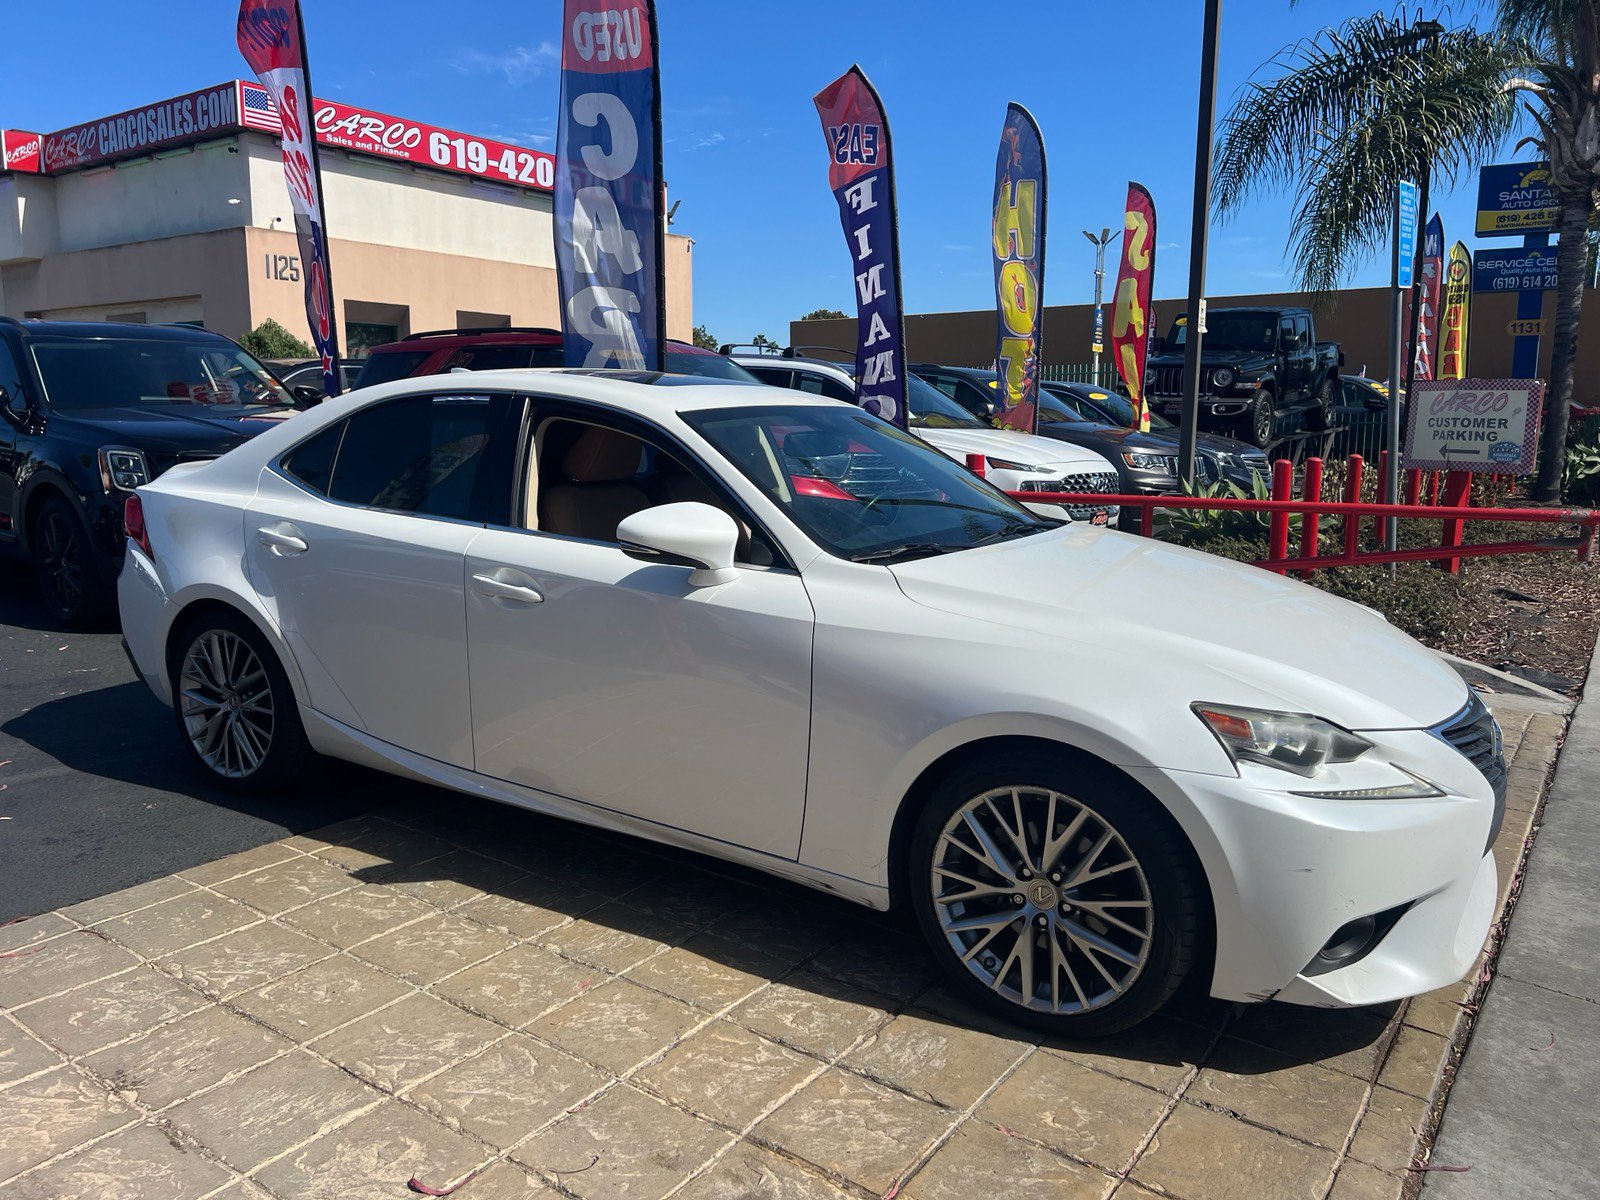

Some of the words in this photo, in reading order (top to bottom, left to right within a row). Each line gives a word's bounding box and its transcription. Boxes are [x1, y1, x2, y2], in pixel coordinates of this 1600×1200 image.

[99, 86, 235, 156] CARCOSALES.COM
[314, 106, 422, 149] CARCO
[6, 140, 39, 163] CARCO
[44, 126, 97, 165] CARCO
[326, 133, 353, 147] Sales
[355, 141, 373, 151] and
[374, 144, 410, 159] Finance
[429, 132, 554, 188] 619-420
[1501, 200, 1531, 209] AUTO
[1496, 213, 1521, 223] (619)
[1523, 211, 1545, 221] 426
[265, 253, 300, 283] 1125
[1477, 258, 1534, 270] SERVICE
[1500, 267, 1524, 275] Quality
[1492, 276, 1520, 290] (619)
[1523, 275, 1542, 288] 614
[1511, 321, 1540, 334] 1131
[1429, 391, 1509, 416] CARCO
[1428, 417, 1508, 429] CUSTOMER
[1432, 430, 1498, 442] PARKING
